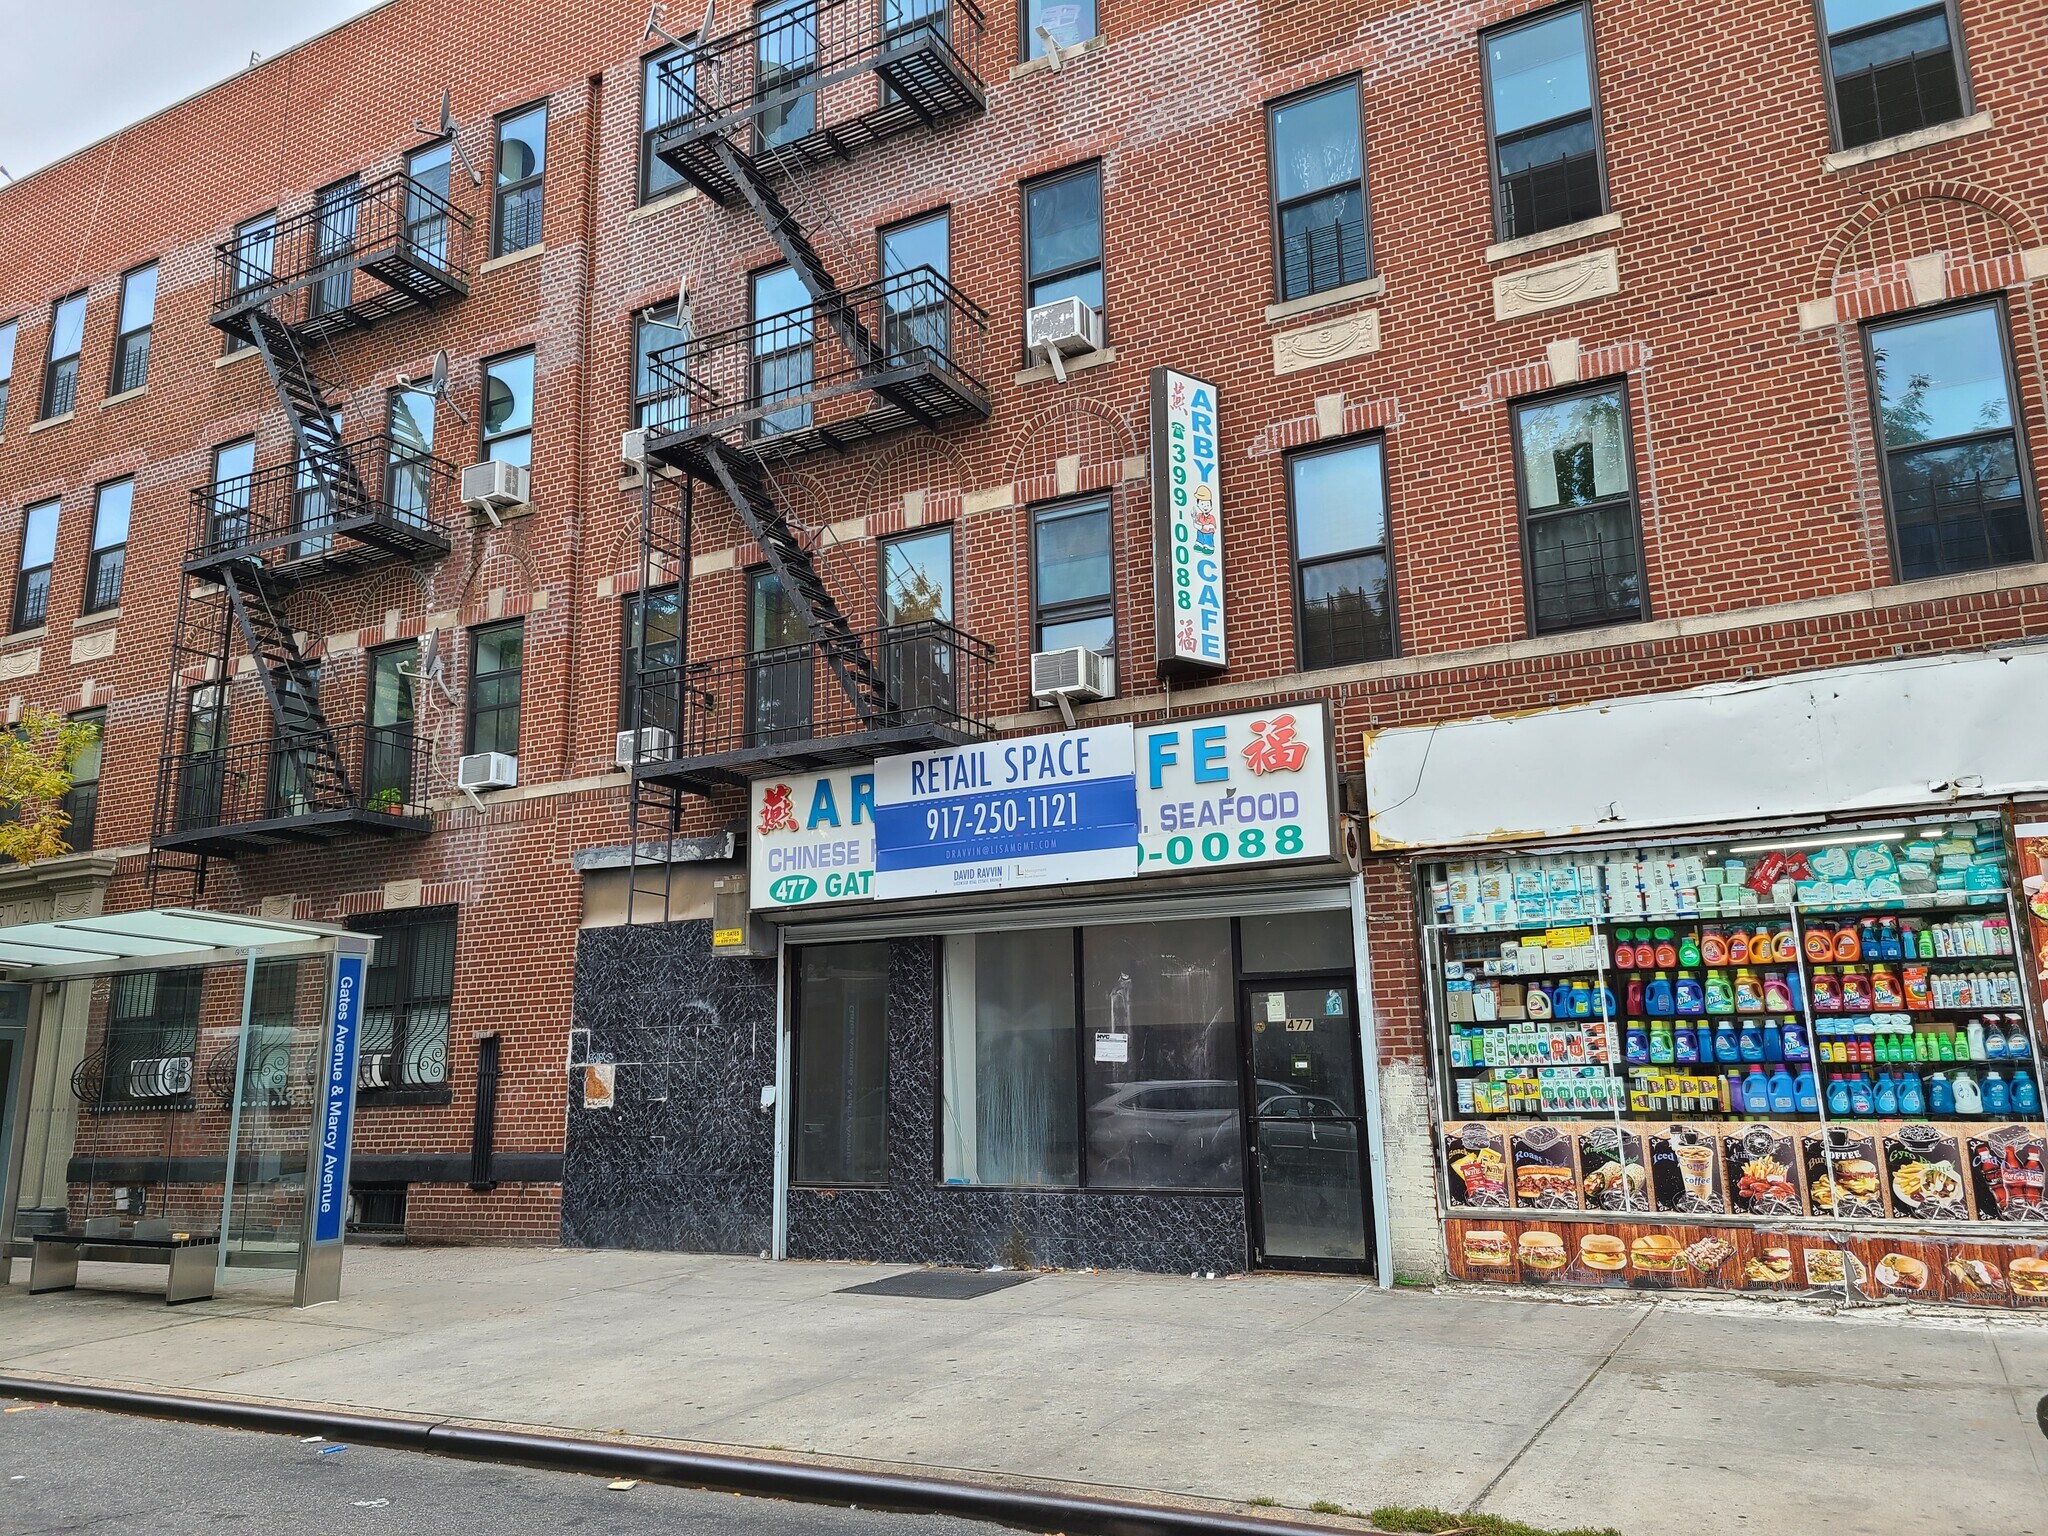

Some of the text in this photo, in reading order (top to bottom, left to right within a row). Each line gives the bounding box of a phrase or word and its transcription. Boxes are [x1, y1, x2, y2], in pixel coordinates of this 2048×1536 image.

[1172, 443, 1192, 610] 399-0088
[1190, 388, 1221, 659] ARBY CAFE
[1241, 713, 1309, 776] 福
[1148, 724, 1230, 789] FE
[911, 737, 1091, 796] RETAIL SPACE
[926, 791, 1078, 840] 917-250-1121
[768, 839, 860, 873] CHINESE
[1160, 790, 1299, 831] SEAFOOD
[945, 839, 1058, 859] DRAVVIN@LISAMGMT.COM
[775, 824, 1304, 900] 477 GAT -0088
[953, 868, 975, 880] DAVID
[976, 866, 1003, 878] RAVVIN
[1677, 995, 1692, 1005] XTRA
[1707, 994, 1722, 1004] XTRA
[1737, 993, 1752, 1003] XTRA
[1814, 991, 1830, 1003] XTRA
[1843, 991, 1860, 1003] XTRA
[1875, 990, 1891, 1001] XTRA
[1287, 1019, 1312, 1031] 477
[1627, 1046, 1640, 1054] XTRA
[1651, 1046, 1663, 1054] XTRA
[1677, 1046, 1689, 1054] XTRA
[1784, 1041, 1800, 1051] XTRA
[320, 976, 353, 1214] Gates Avenue & Marcy Avenue
[1515, 1151, 1543, 1163] Roast
[1653, 1152, 1675, 1165] Iced
[1889, 1150, 1916, 1162] Gyro
[1685, 1176, 1711, 1187] coffee
[1747, 1280, 1774, 1288] BURGER
[1882, 1287, 1938, 1297] PANCAKE PLATTER
[1972, 1292, 2007, 1300] SANDWICH
